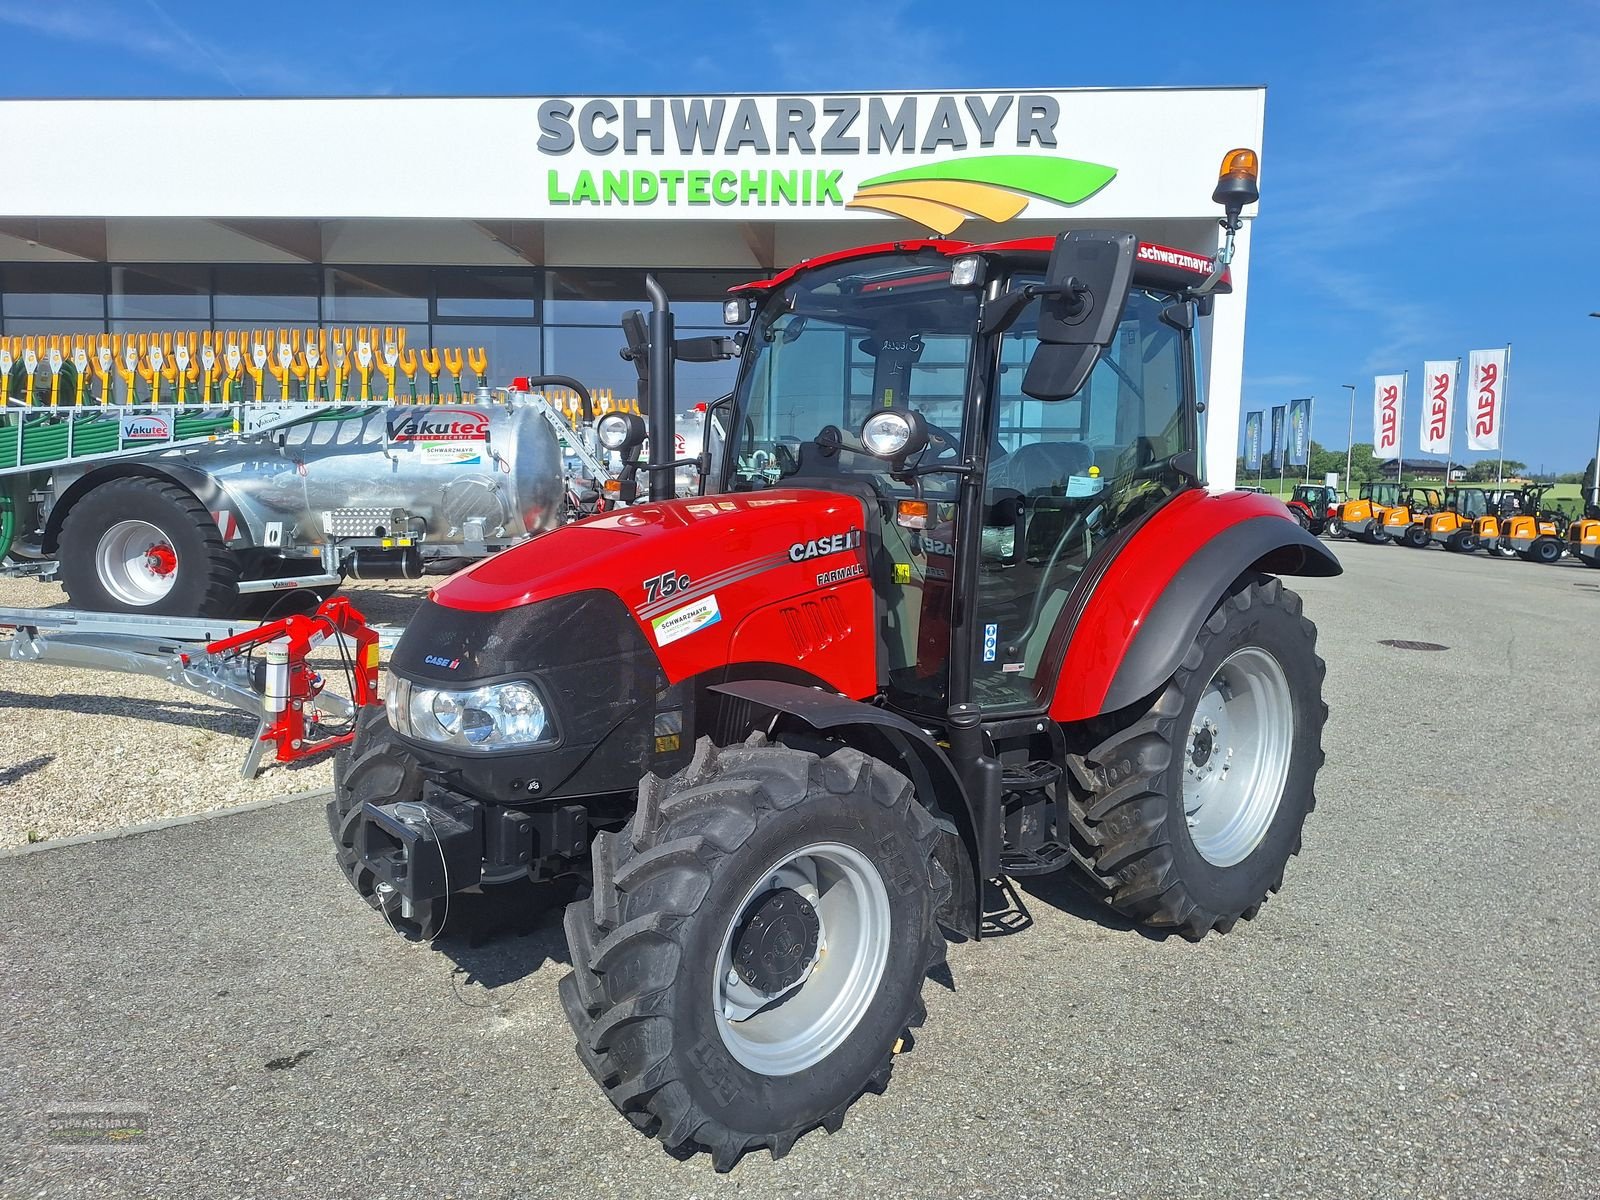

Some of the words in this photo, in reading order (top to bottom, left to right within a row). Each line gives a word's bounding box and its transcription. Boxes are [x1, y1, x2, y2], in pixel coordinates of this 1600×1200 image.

[537, 95, 1061, 156] SCHWARZMAYR
[548, 169, 845, 207] LANDTECHNIK
[1138, 246, 1215, 273] .schwarzmayr.a
[125, 424, 168, 438] Vakutec
[387, 416, 490, 441] Vakutec
[789, 533, 843, 562] CASE
[816, 563, 865, 587] FARMALL
[661, 605, 707, 630] SCHWARZMAYR
[424, 654, 450, 667] CASE
